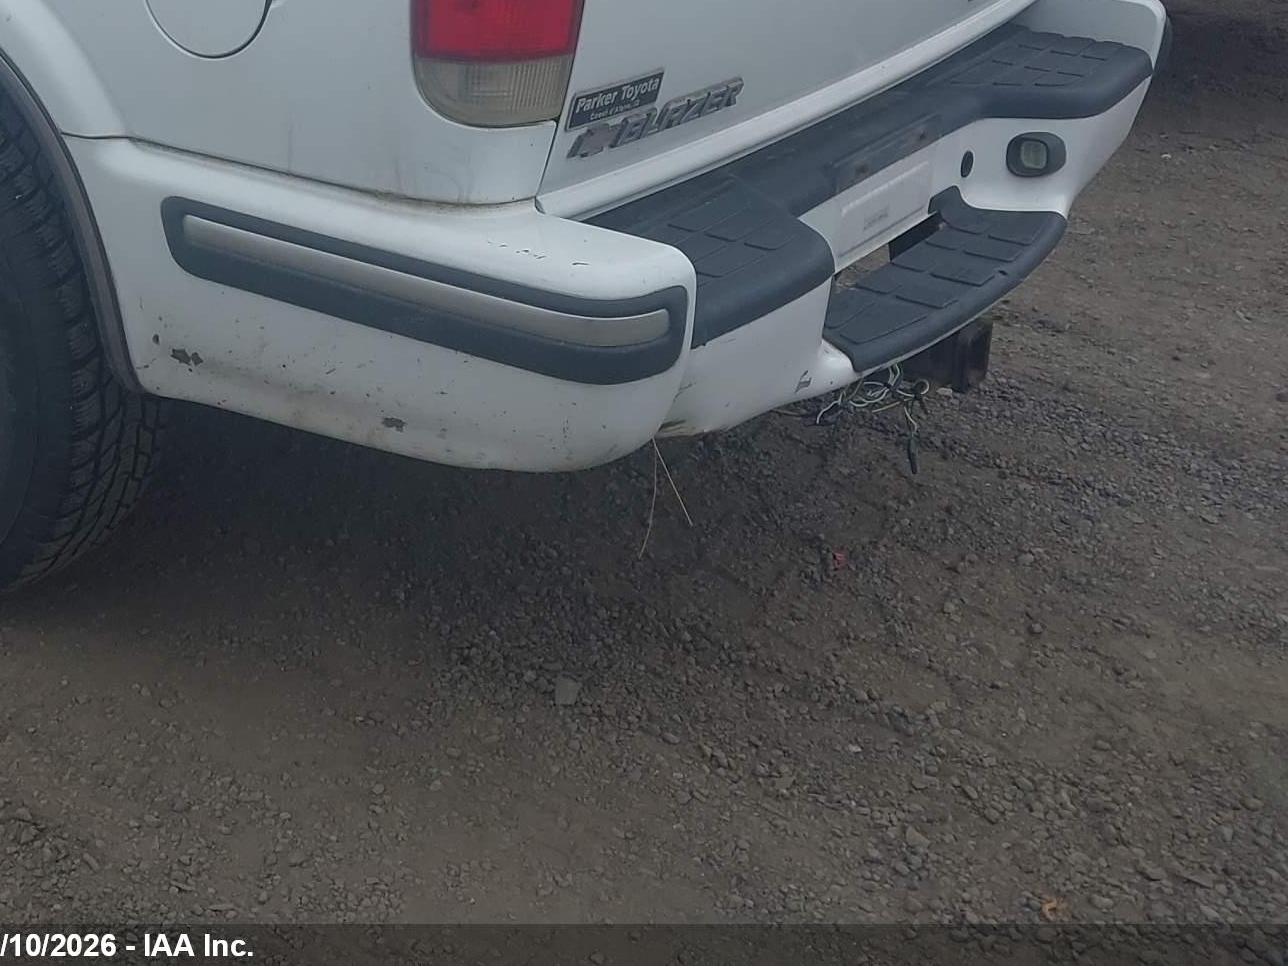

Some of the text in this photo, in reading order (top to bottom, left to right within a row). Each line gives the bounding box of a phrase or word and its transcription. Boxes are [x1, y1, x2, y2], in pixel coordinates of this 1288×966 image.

[575, 90, 618, 114] Parker
[622, 77, 660, 101] Toyota
[616, 76, 745, 148] BLAZER
